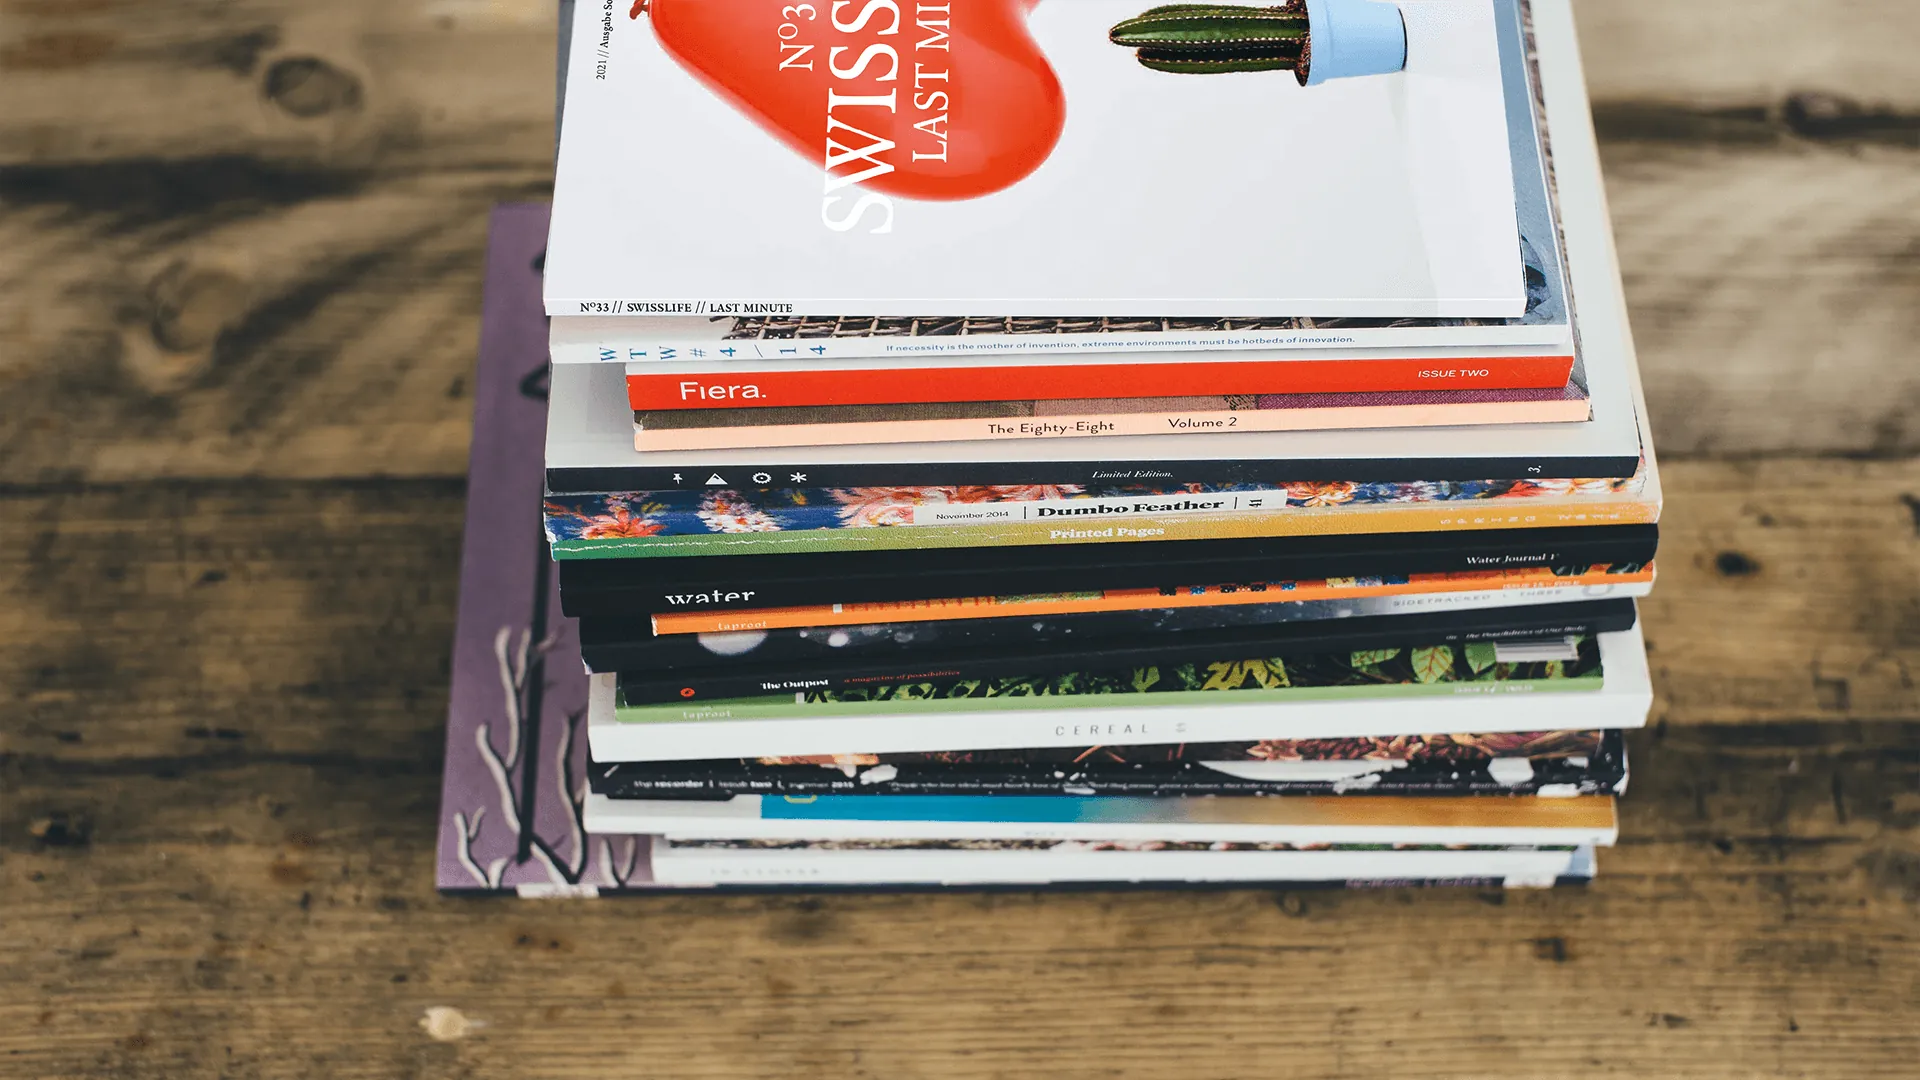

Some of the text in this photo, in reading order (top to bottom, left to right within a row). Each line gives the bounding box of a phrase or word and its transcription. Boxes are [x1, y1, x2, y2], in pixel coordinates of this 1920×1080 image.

[600, 11, 614, 48] Ausgabe
[596, 60, 607, 80] 2021
[911, 2, 951, 163] LAST MI
[821, 0, 902, 234] SWISS
[627, 302, 693, 314] SWISSLIFE
[709, 302, 741, 313] LAST
[743, 302, 793, 314] MINUTE
[895, 344, 945, 352] necessity
[1029, 341, 1080, 350] invention,
[1126, 339, 1197, 347] environments
[1227, 337, 1240, 345] be
[1242, 337, 1284, 345] hotbeds
[1286, 336, 1297, 344] of
[1299, 335, 1356, 344] innovation.
[1418, 369, 1489, 378] ISSUE TWO
[679, 381, 767, 400] Fiera.
[988, 416, 1238, 436] The Eighty-Eight Volume 2
[1092, 470, 1173, 479] Limited Edition.
[936, 497, 1263, 521] November 2014 Dumbo Feather 41
[1050, 526, 1165, 540] Printed Pages
[1466, 556, 1501, 565] Water
[1501, 553, 1547, 564] Journal
[665, 589, 756, 605] water
[1393, 593, 1492, 607] SIDETRACKED
[717, 620, 768, 632] taproot
[760, 678, 829, 690] The Outpost
[1055, 723, 1148, 737] CEREAL
[654, 779, 705, 789] recorder
